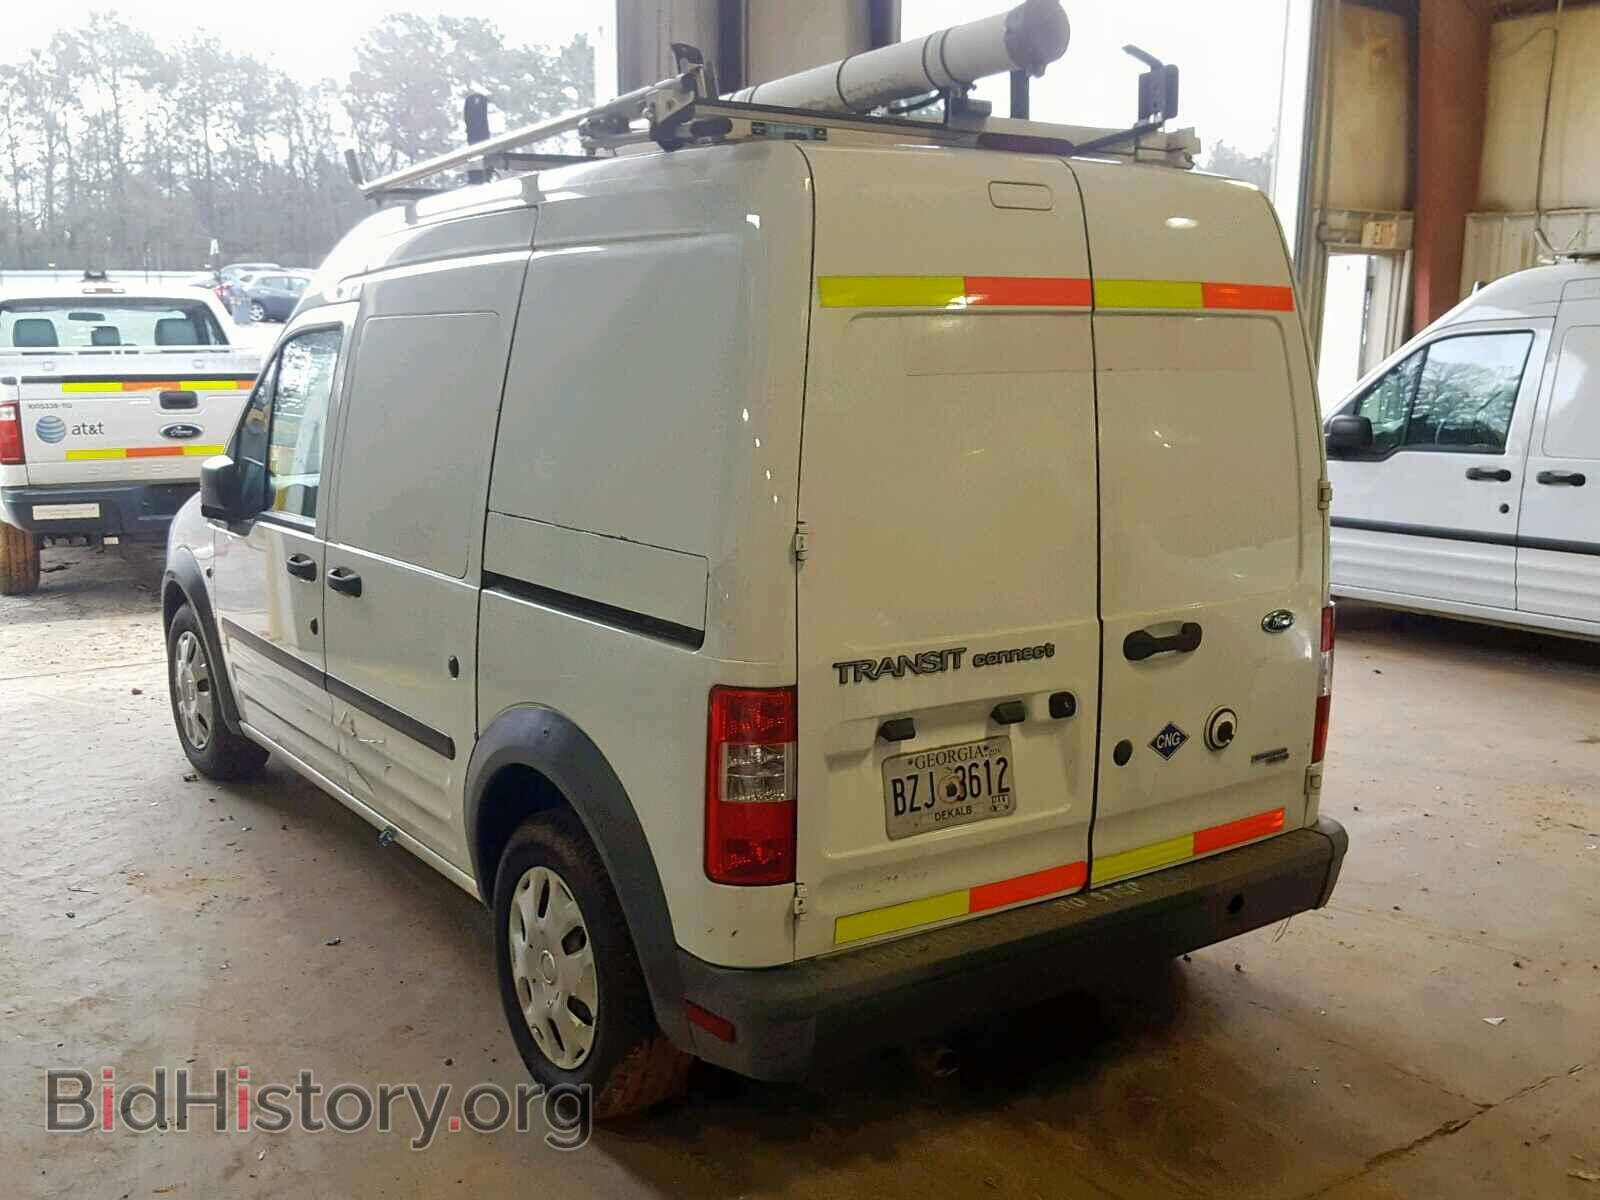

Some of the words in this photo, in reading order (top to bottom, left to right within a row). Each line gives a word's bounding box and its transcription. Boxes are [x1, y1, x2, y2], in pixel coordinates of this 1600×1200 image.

[72, 421, 105, 436] at&t
[832, 647, 967, 685] TRANSIT
[972, 642, 1055, 668] connect
[1156, 731, 1182, 749] CNG
[914, 747, 984, 770] GEORGIA
[890, 772, 936, 816] BZJ
[953, 757, 1011, 802] 3612
[934, 805, 973, 823] DEKALB
